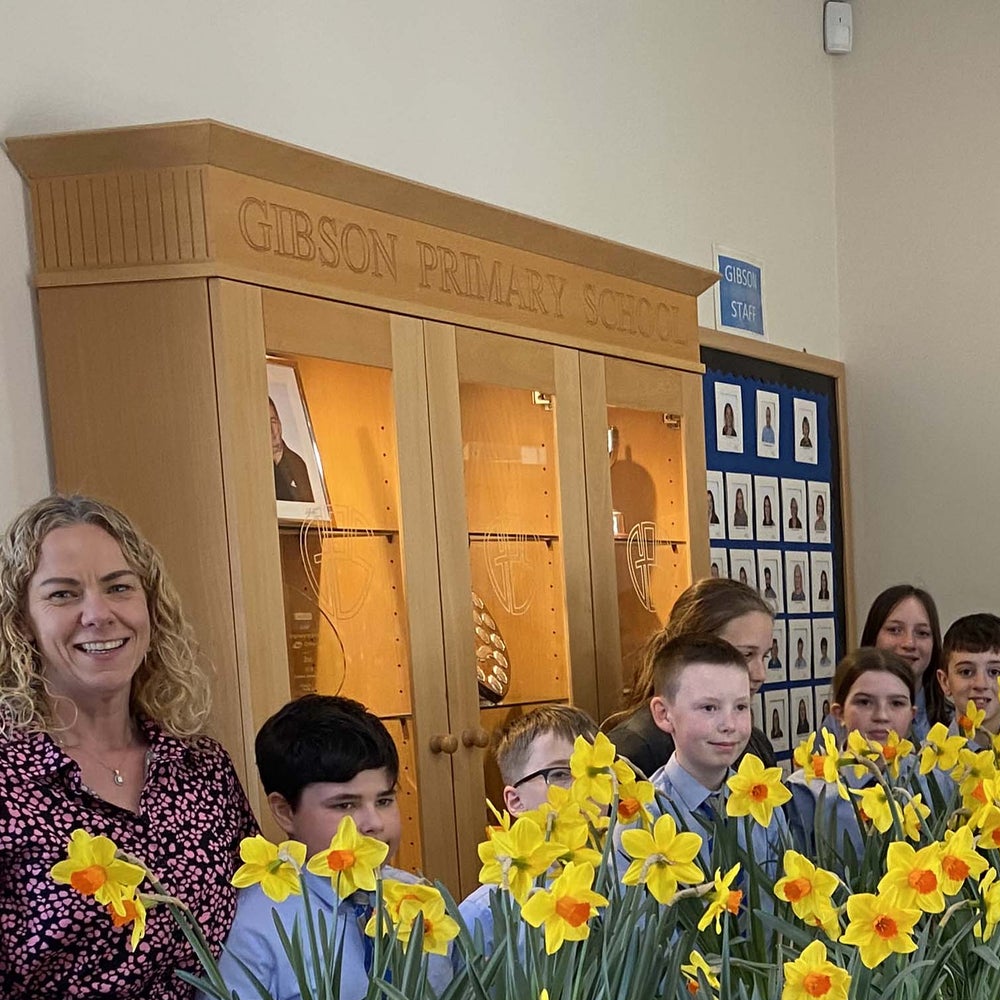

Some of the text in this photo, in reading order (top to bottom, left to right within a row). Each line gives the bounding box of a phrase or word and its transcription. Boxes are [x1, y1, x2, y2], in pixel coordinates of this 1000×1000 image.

[238, 196, 687, 345] GIBSON PRIMARY SCHOOL
[724, 264, 758, 289] GIBSON
[731, 300, 757, 322] STAFF
